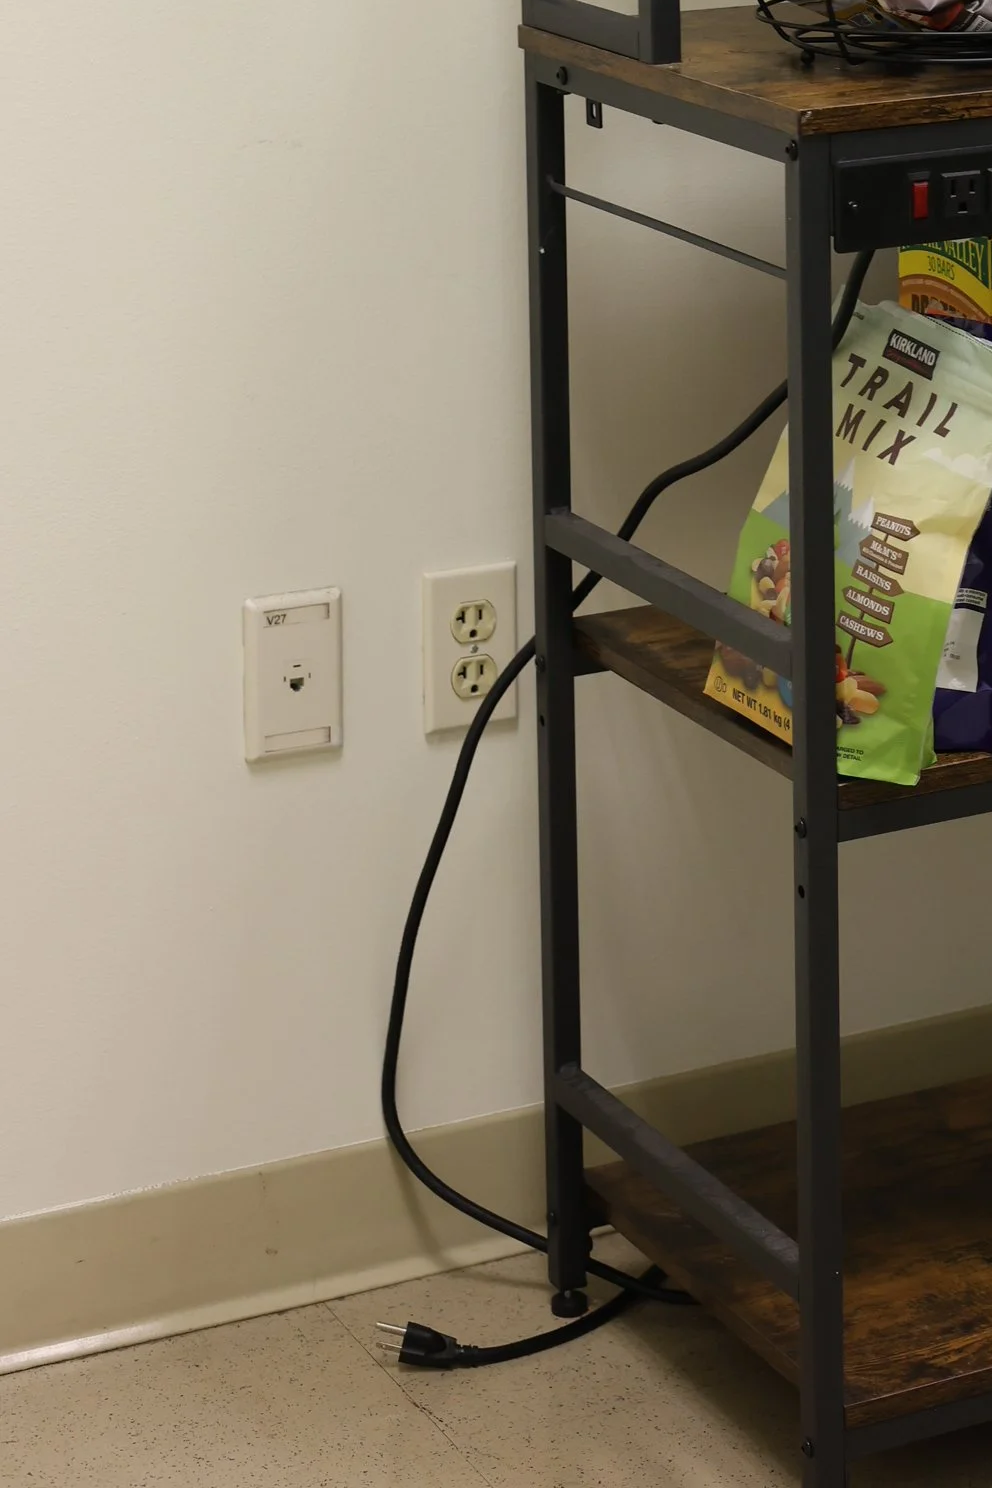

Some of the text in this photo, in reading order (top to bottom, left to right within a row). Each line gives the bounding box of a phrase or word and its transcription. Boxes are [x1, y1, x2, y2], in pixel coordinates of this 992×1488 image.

[927, 255, 955, 281] 30 BARS
[942, 239, 985, 281] VALLEY
[889, 332, 938, 367] KIRKLAND
[840, 352, 958, 438] TRAIL
[835, 404, 915, 466] MIX
[875, 516, 912, 536] PEANUTS
[856, 565, 892, 591] RAISINS
[846, 589, 890, 616] ALMONDS
[265, 614, 287, 627] V27
[839, 615, 885, 641] CASHEWS
[732, 688, 745, 705] NET
[746, 697, 757, 711] WT
[758, 703, 772, 720] 1.81
[773, 711, 782, 728] kg
[842, 754, 862, 762] DETAIL
